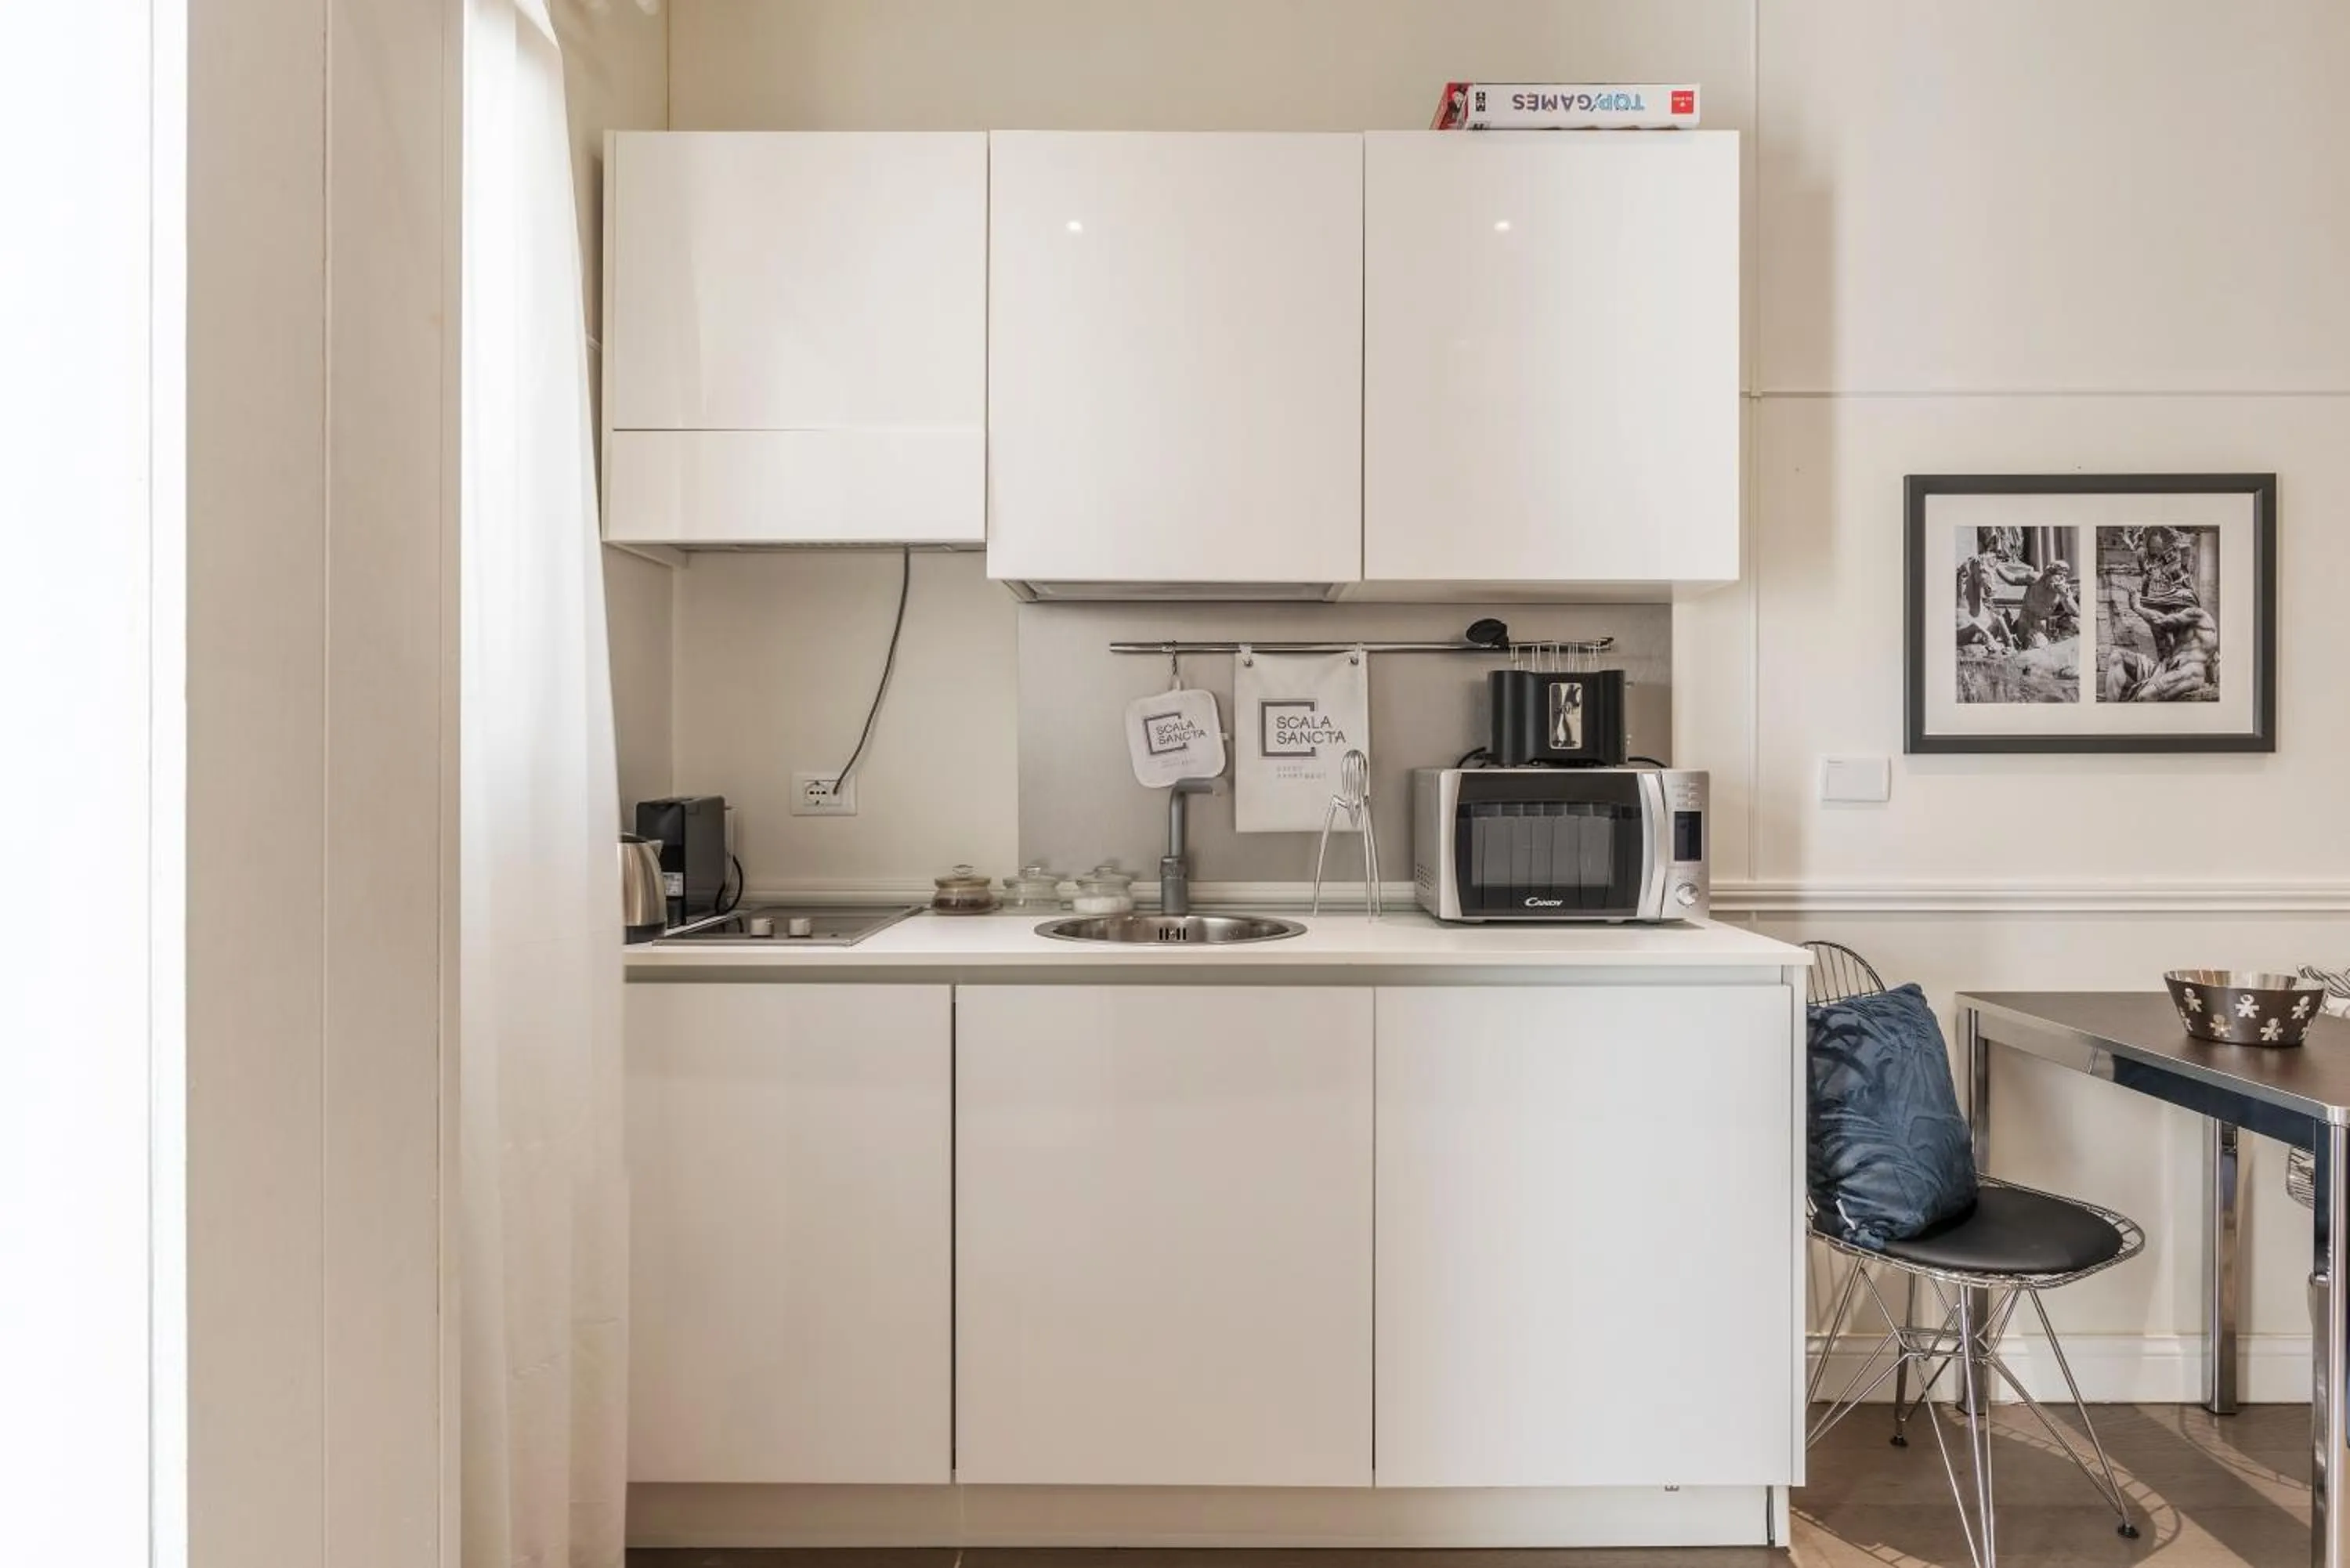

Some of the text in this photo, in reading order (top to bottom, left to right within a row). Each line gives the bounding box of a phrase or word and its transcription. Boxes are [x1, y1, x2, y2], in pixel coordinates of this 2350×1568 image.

[1156, 720, 1195, 735] SCALA
[1277, 715, 1332, 729] SCALA
[1159, 729, 1207, 745] SANCTA
[1277, 730, 1346, 744] SANCTA
